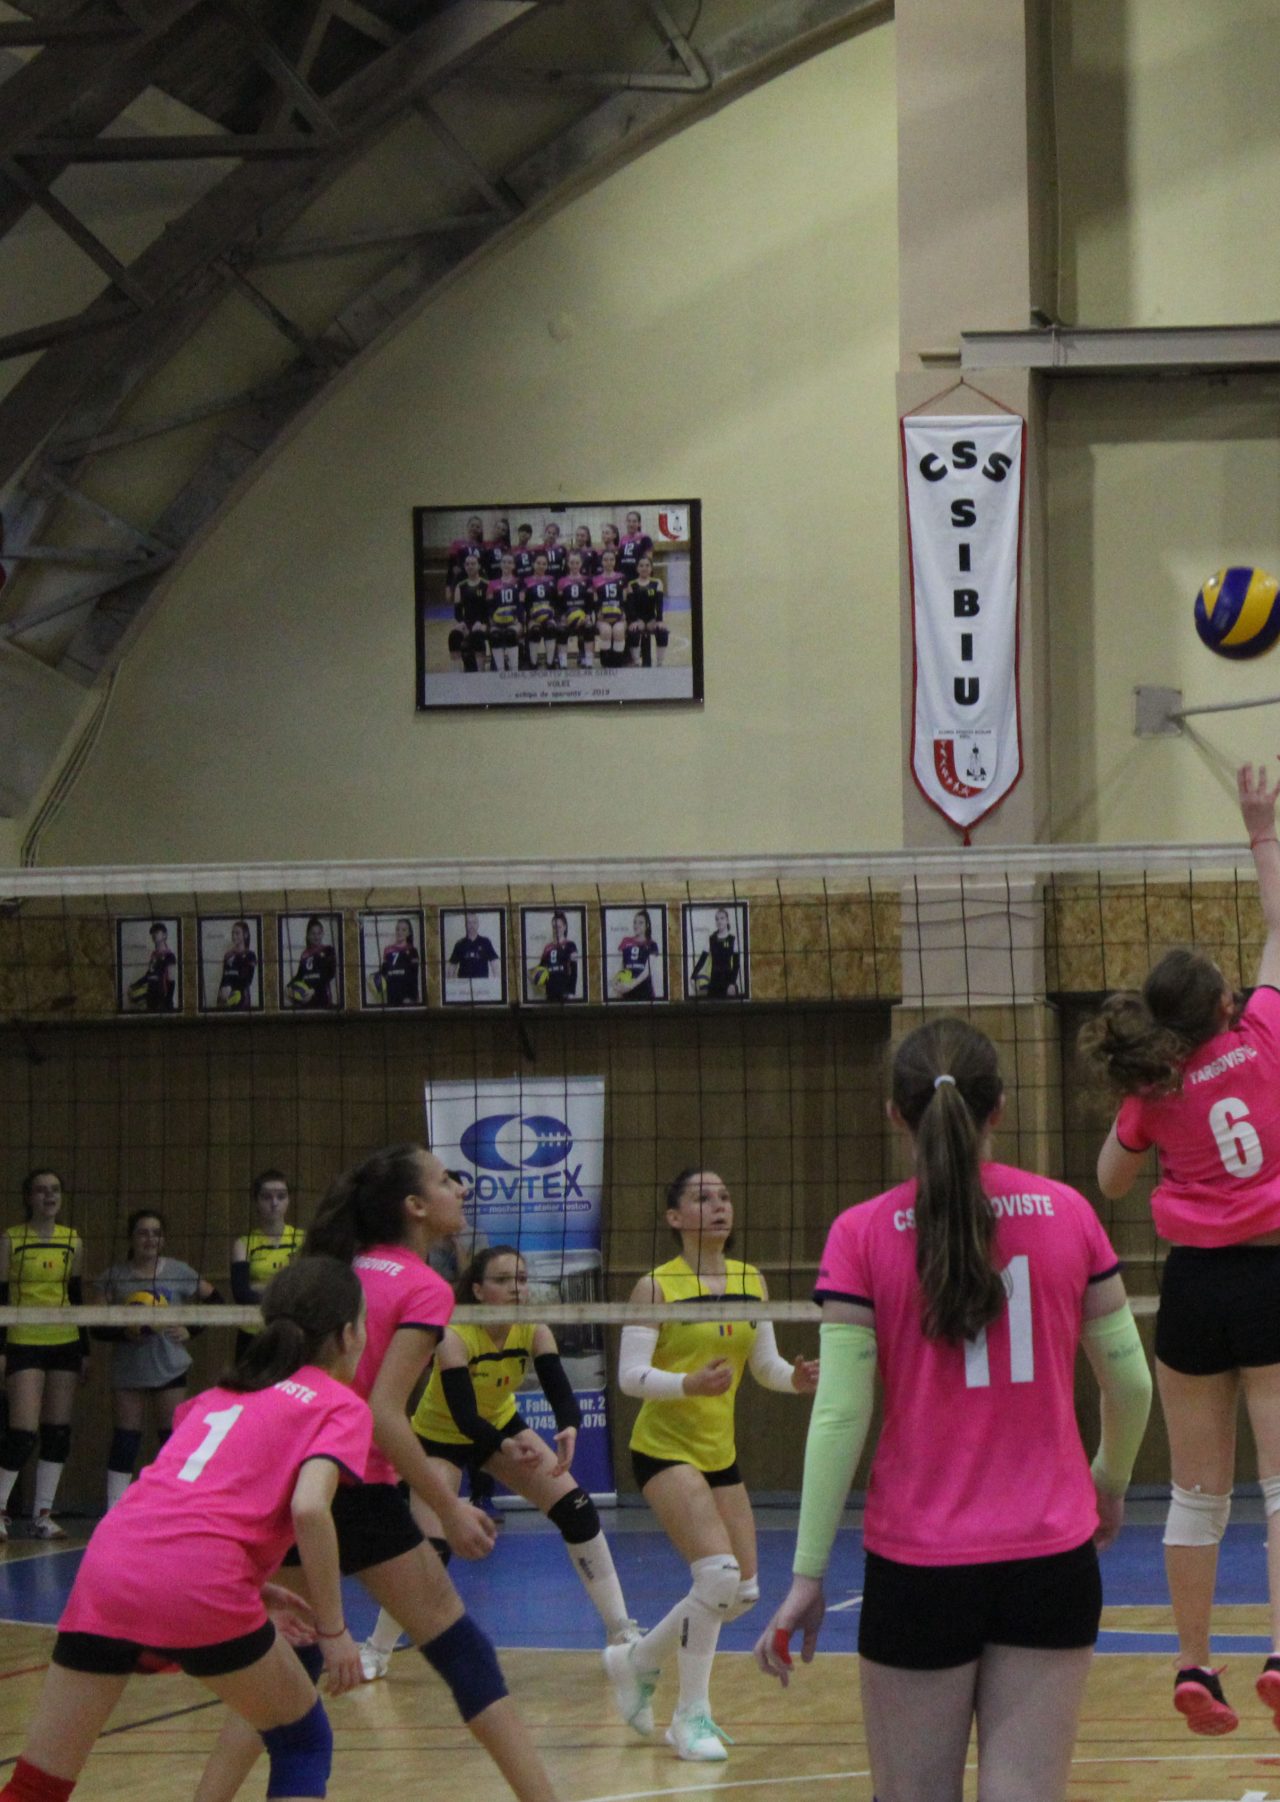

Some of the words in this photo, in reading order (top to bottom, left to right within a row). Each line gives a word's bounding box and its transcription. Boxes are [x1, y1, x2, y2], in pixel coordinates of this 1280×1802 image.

[919, 440, 1012, 483] CSS
[950, 498, 981, 706] SIBIU
[1209, 1097, 1264, 1179] 6
[177, 1403, 244, 1483] 1
[598, 1396, 606, 1410] 2
